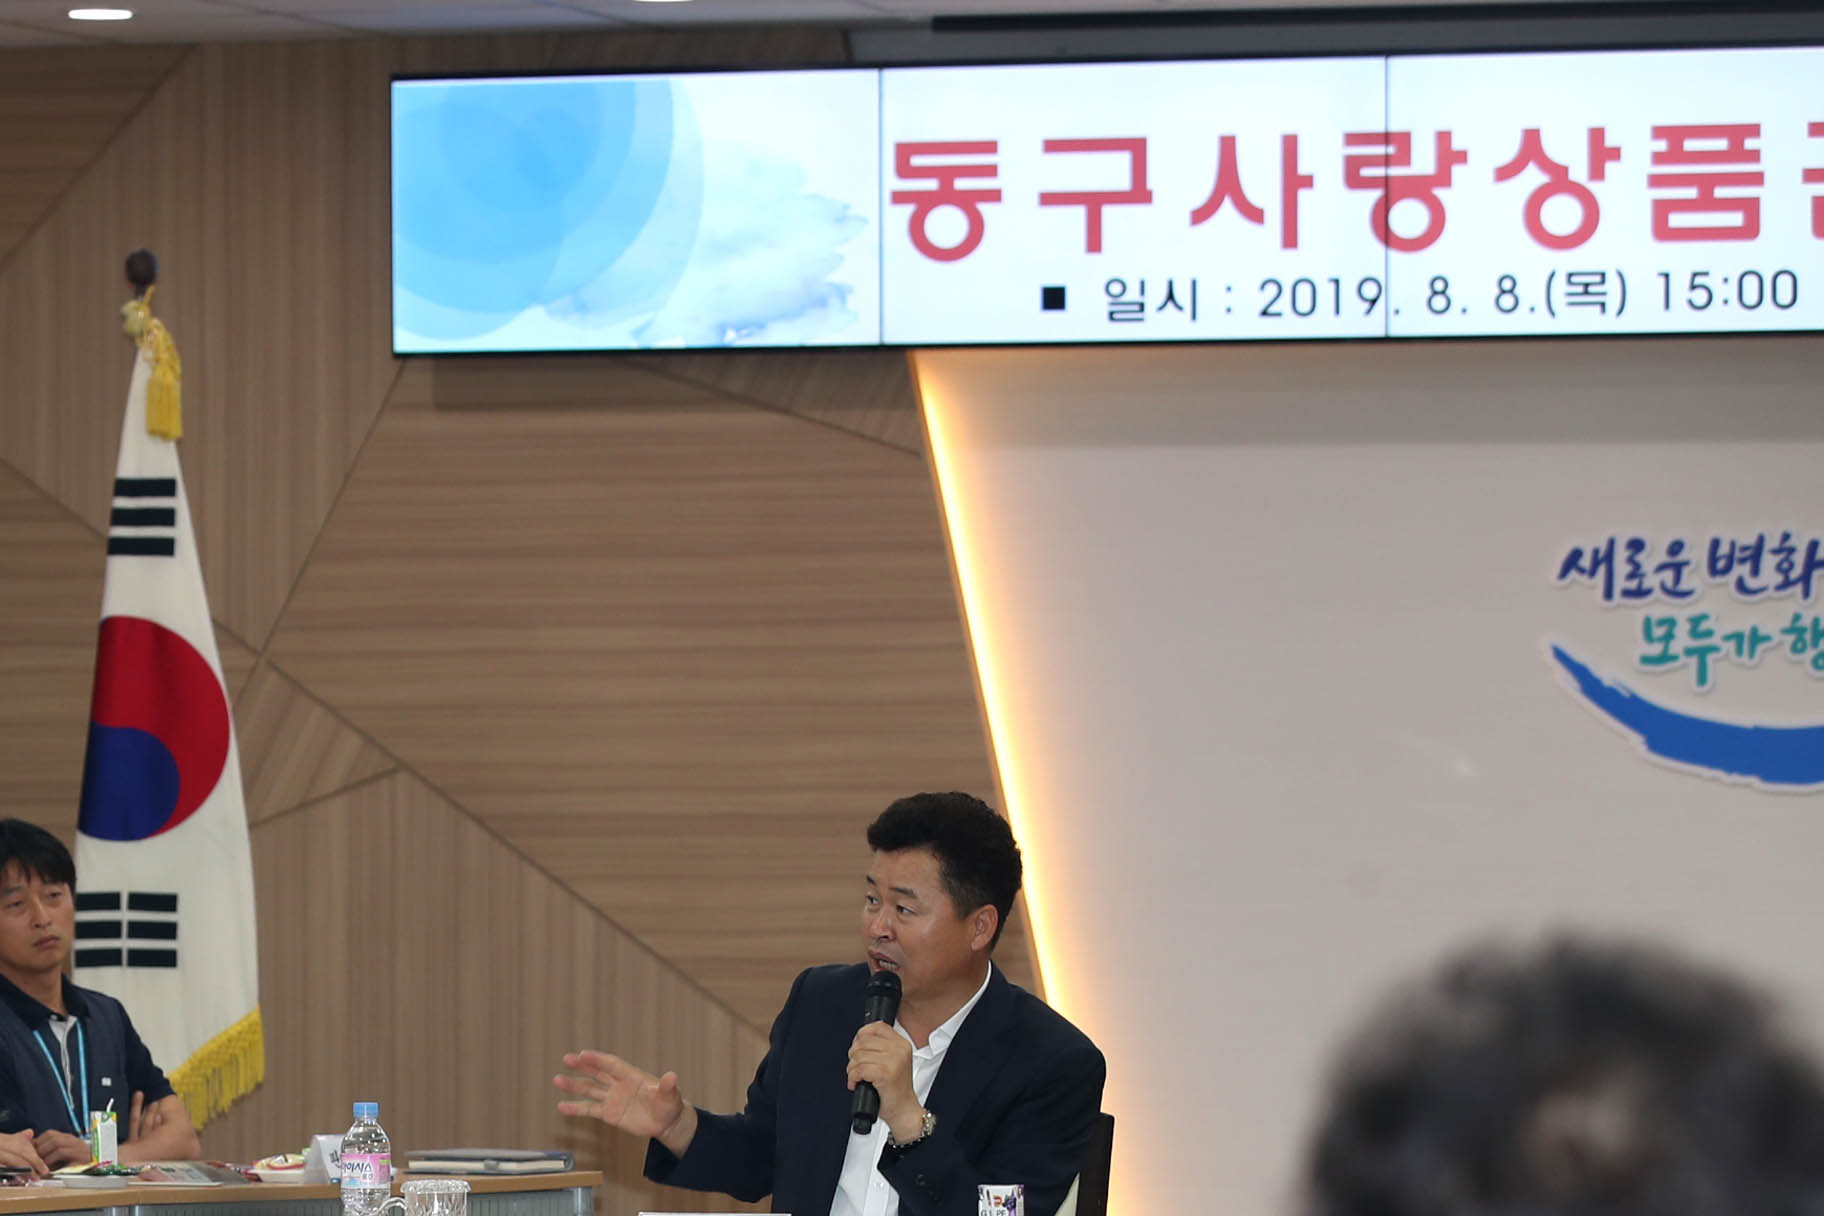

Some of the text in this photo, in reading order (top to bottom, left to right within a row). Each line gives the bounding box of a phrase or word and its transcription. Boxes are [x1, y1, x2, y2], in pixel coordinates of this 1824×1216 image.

[890, 121, 1824, 263] 동구사랑상품
[1104, 277, 1197, 322] 일시
[1657, 269, 1799, 313] 15:00
[1557, 530, 1824, 601] 새로운 변화
[1639, 612, 1773, 688] 모두가
